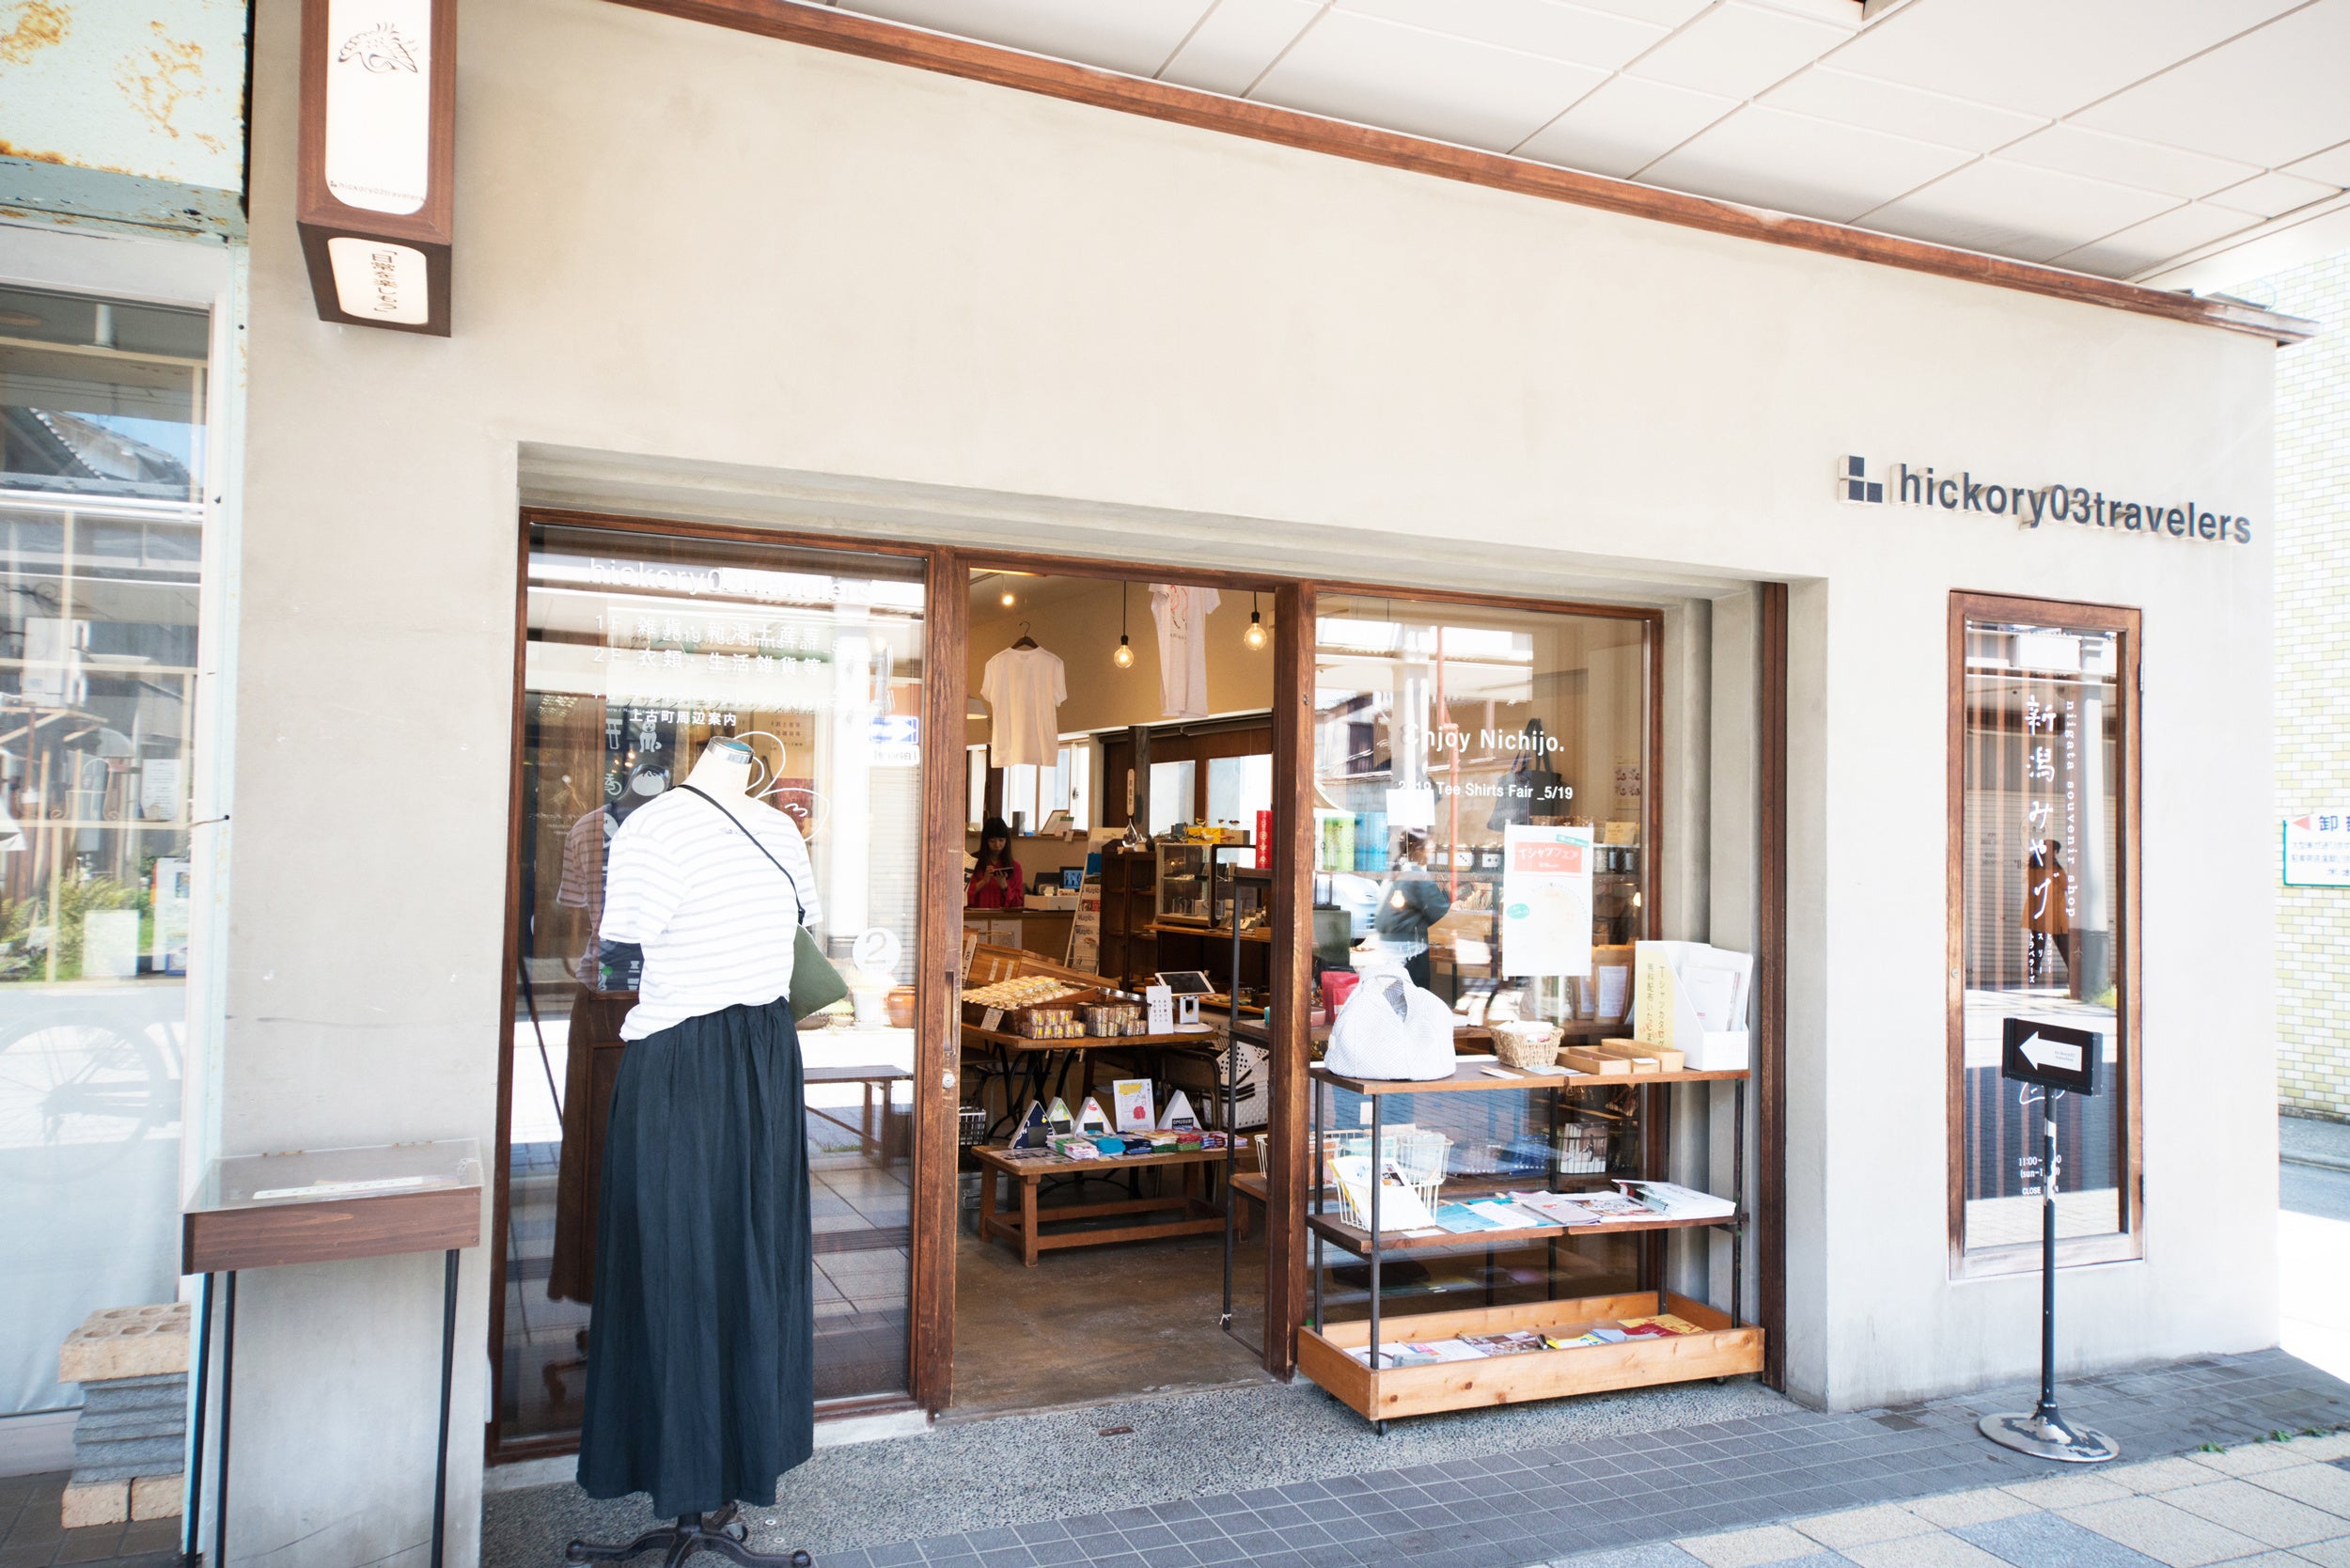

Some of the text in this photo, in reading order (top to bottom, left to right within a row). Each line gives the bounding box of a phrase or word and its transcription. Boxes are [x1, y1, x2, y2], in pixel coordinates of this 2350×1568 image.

[1898, 462, 2251, 545] hickory03travelers
[628, 708, 738, 728] 上古町周辺案内
[1480, 729, 1565, 757] Nichijo.
[1435, 781, 1462, 796] Tee
[1465, 782, 1505, 798] Shirts
[1508, 784, 1534, 799] Fair
[2064, 700, 2077, 918] niigata souvenir shop
[2028, 933, 2037, 984] トラベラーズ
[2021, 1186, 2042, 1196] CLOSE
